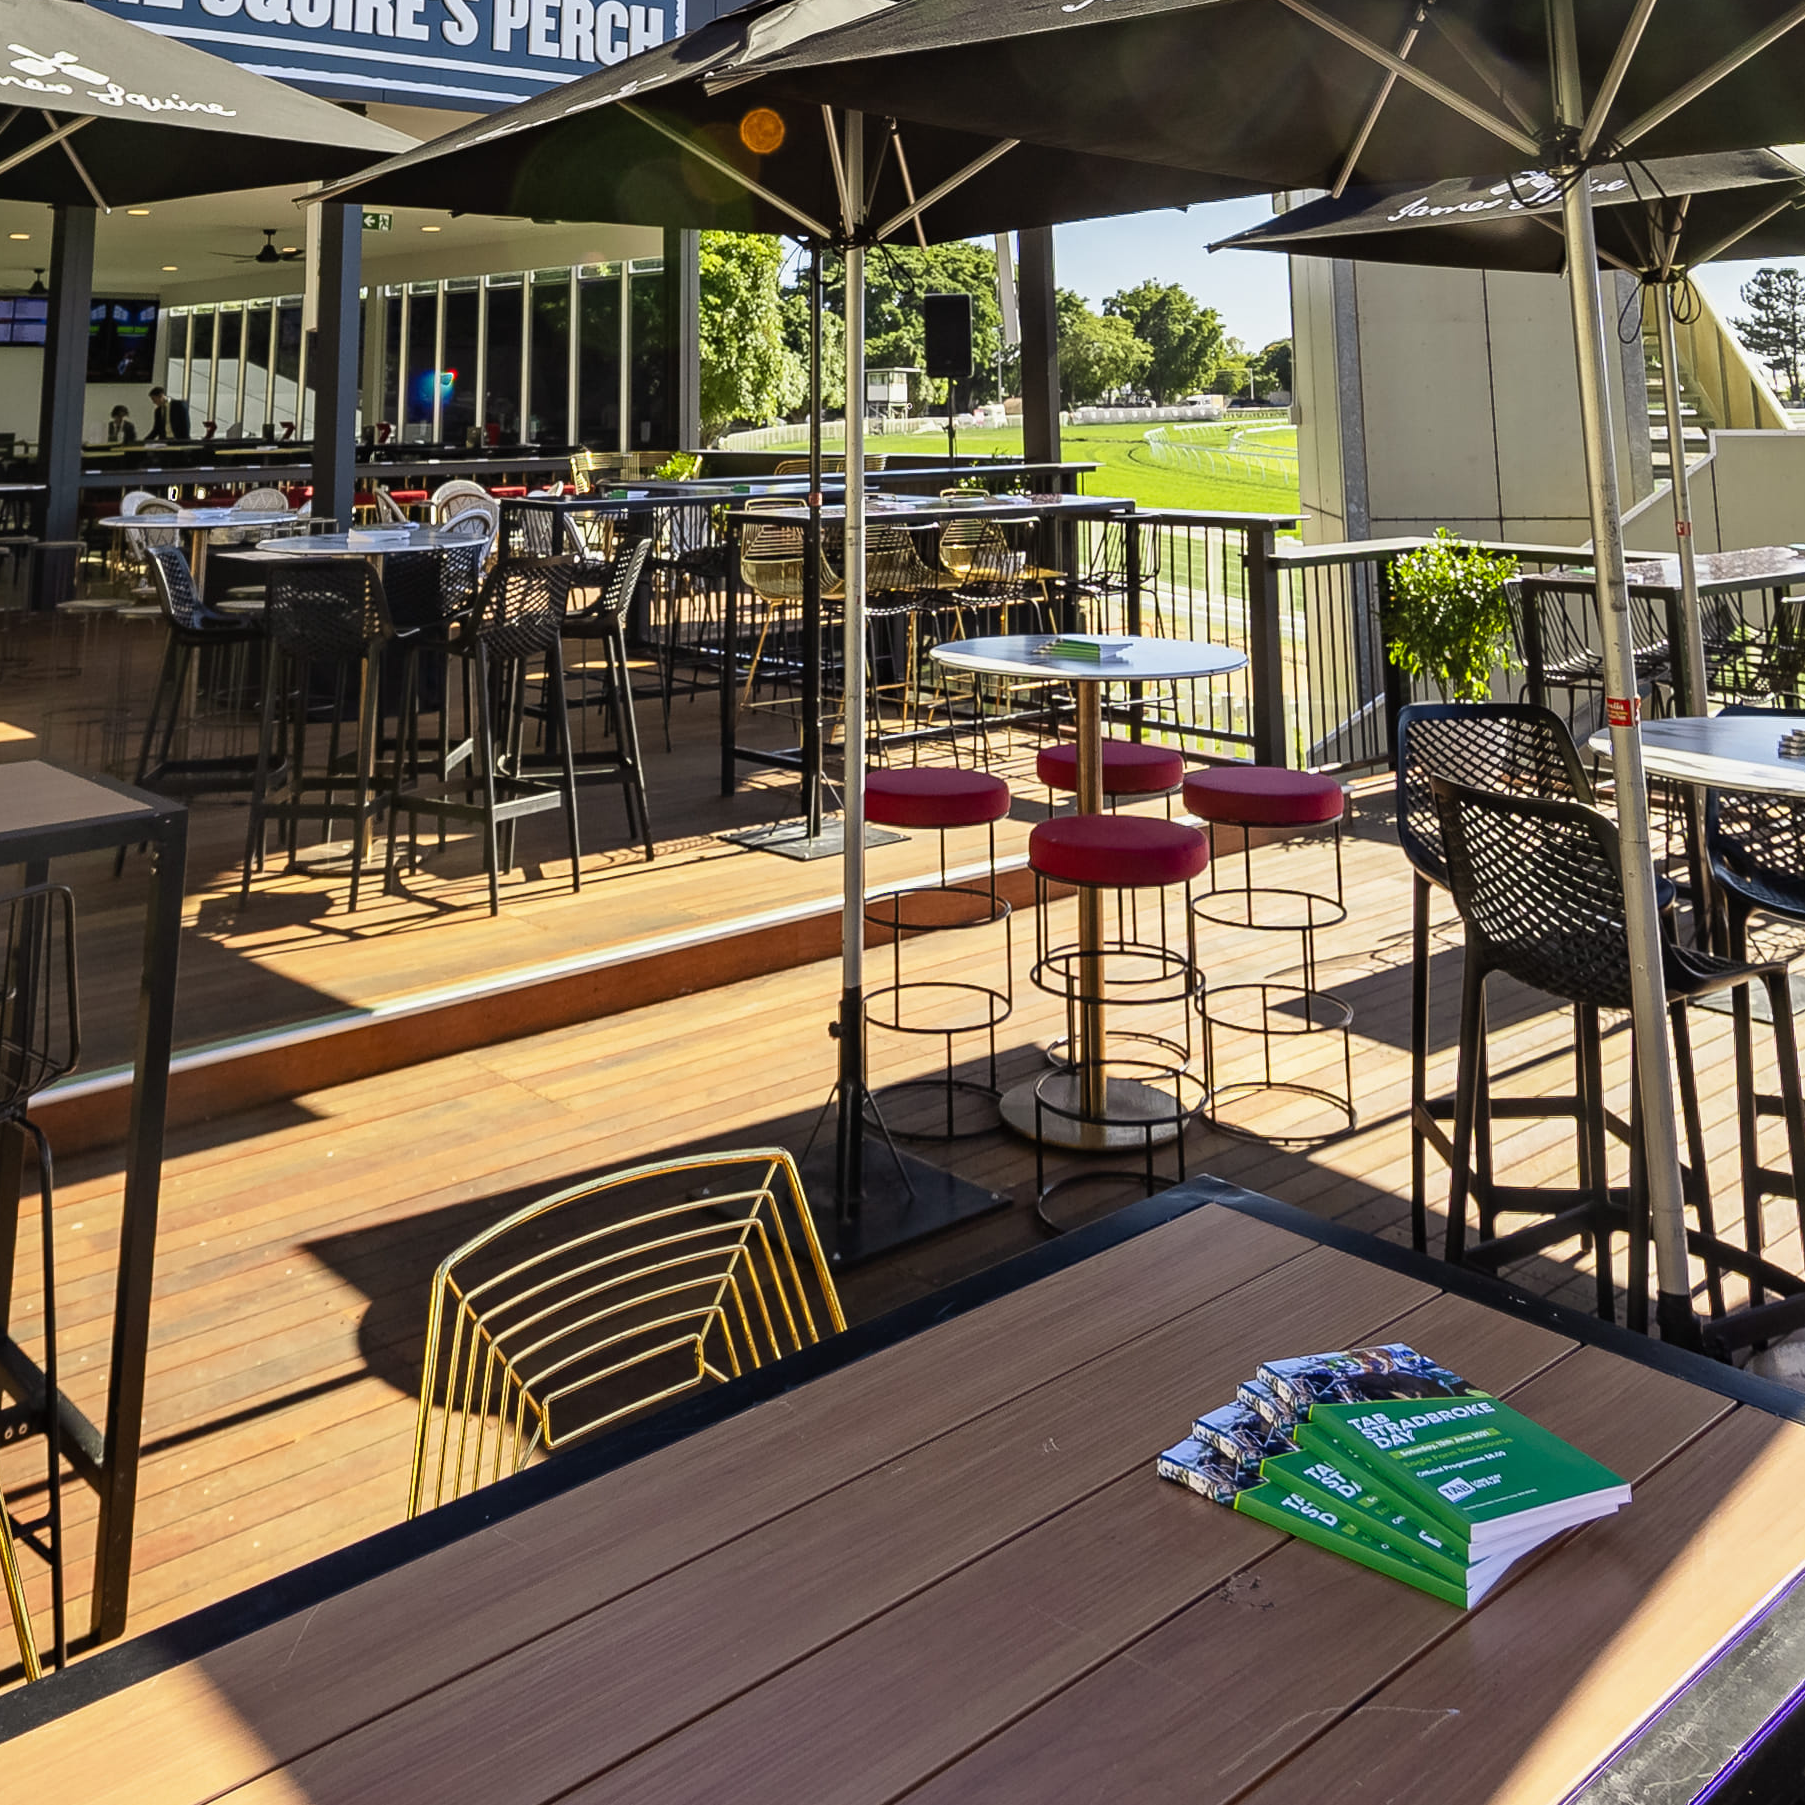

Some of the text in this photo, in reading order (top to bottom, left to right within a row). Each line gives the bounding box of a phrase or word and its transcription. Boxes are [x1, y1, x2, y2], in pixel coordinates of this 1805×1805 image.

[86, 82, 237, 117] Squire
[1387, 196, 1505, 223] James
[1346, 1412, 1390, 1431] TAB
[1361, 1401, 1496, 1439] STRADBROKE
[1373, 1429, 1416, 1450] DAY
[1303, 1461, 1337, 1480] TA
[1441, 1483, 1471, 1496] TAB
